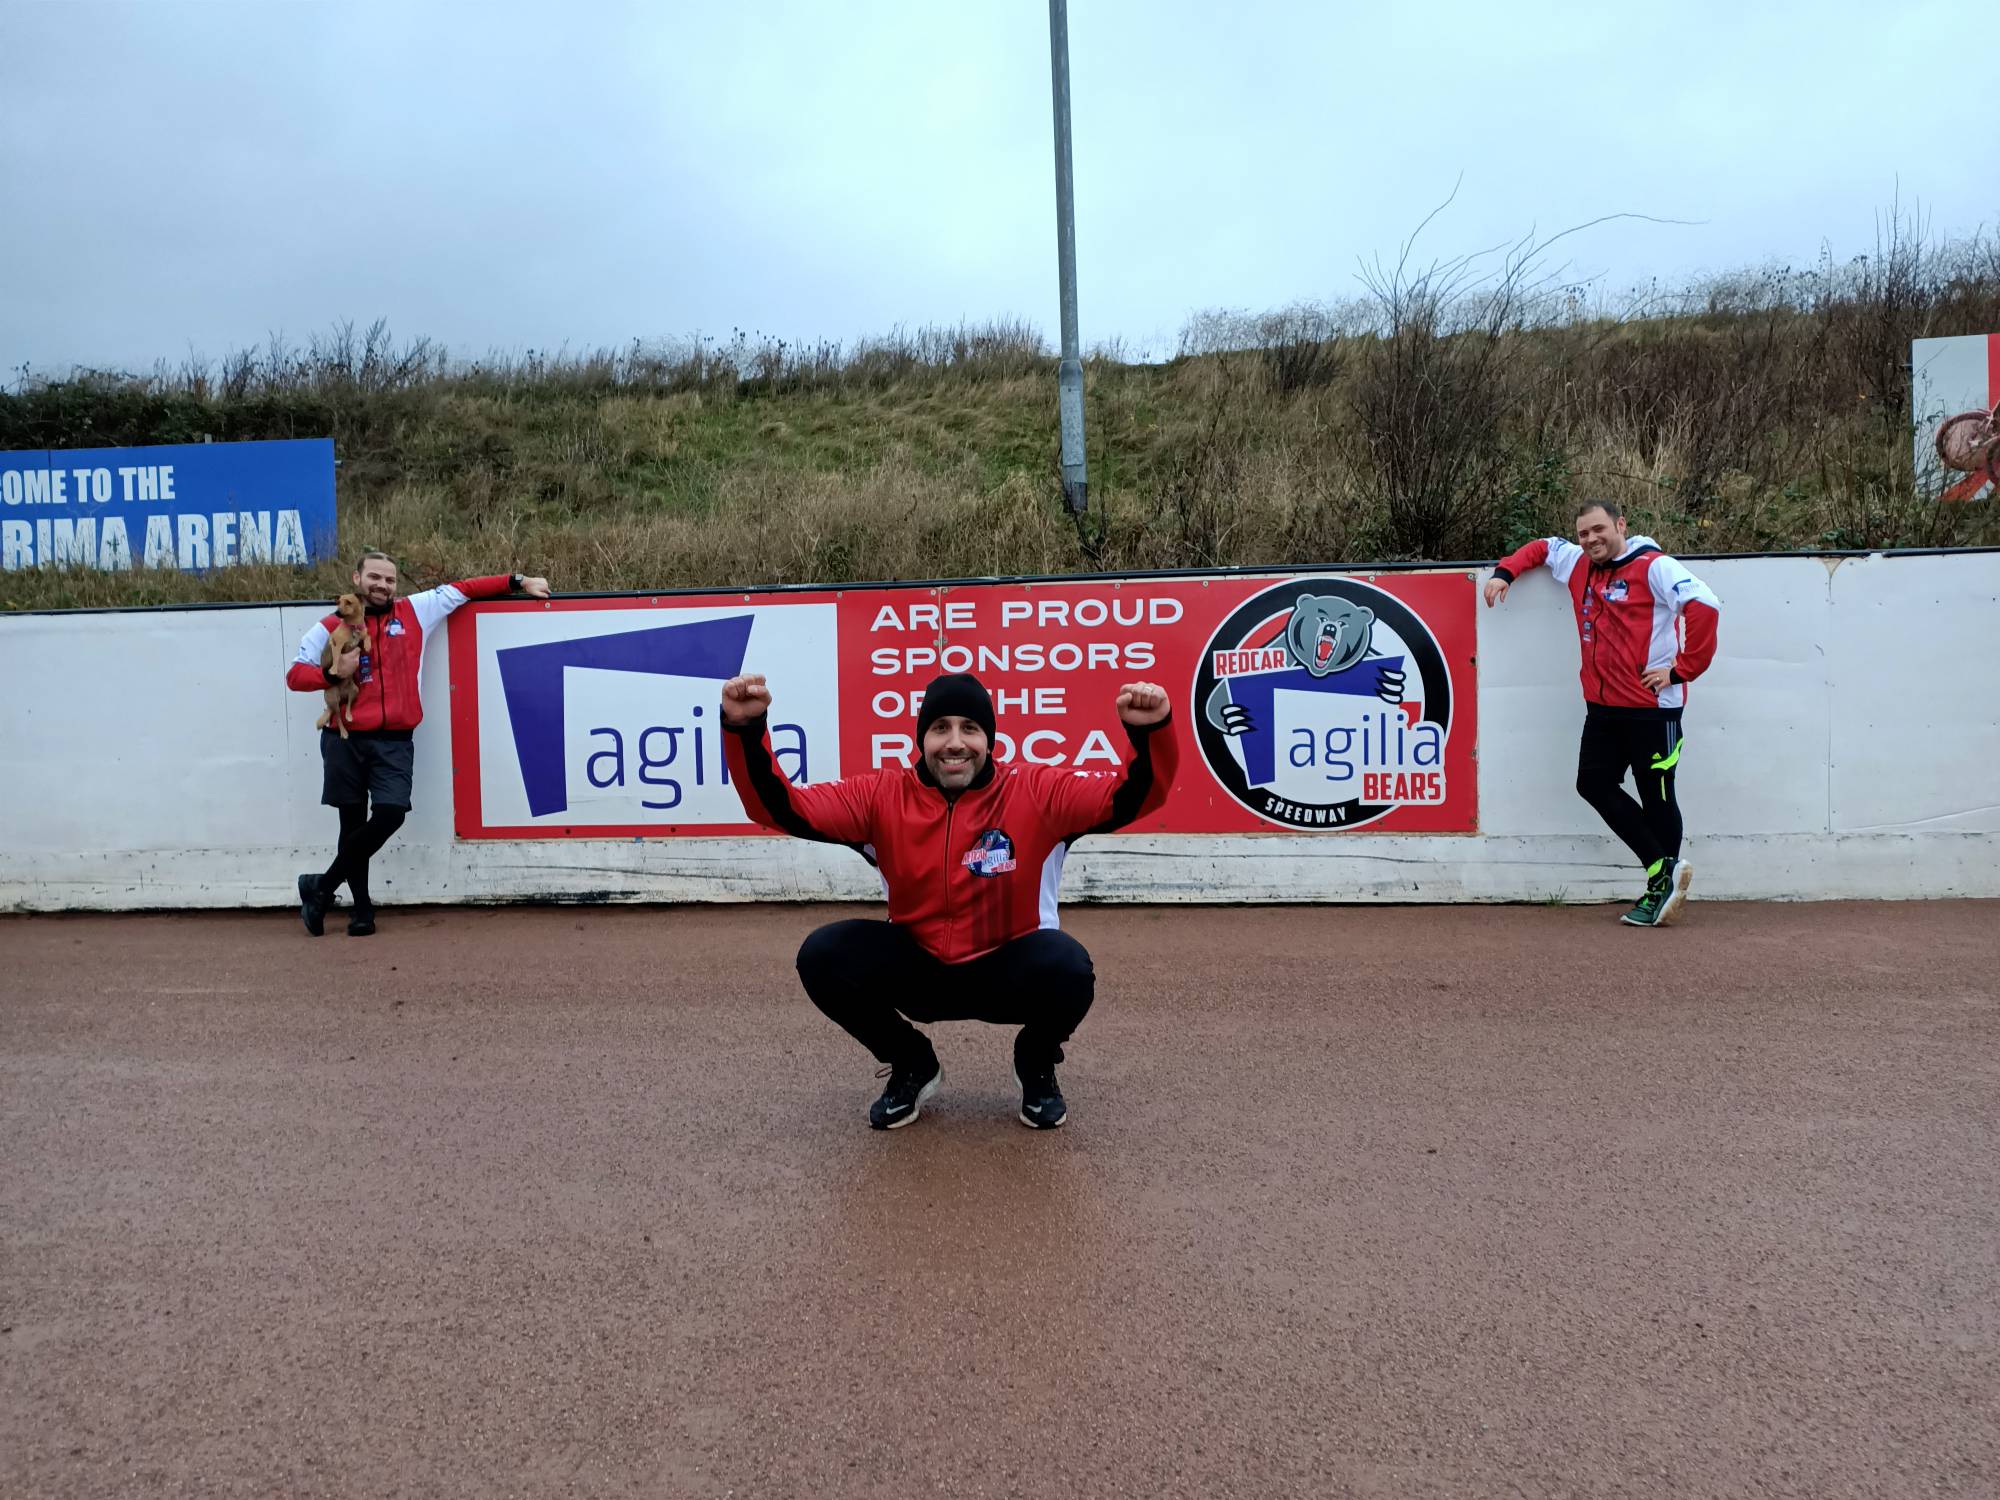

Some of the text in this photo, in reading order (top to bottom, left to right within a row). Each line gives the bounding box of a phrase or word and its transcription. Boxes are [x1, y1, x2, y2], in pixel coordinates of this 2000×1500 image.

[0, 465, 176, 505] OME TO THE
[143, 509, 309, 570] ARENA
[870, 598, 1184, 632] ARE PROUD
[870, 642, 1156, 675] SPONSORS
[1215, 650, 1286, 676] REDCAR
[990, 687, 1067, 714] HE
[1288, 712, 1441, 782] agilia
[1363, 772, 1441, 801] BEARS
[1264, 797, 1346, 824] SPEEDWAY
